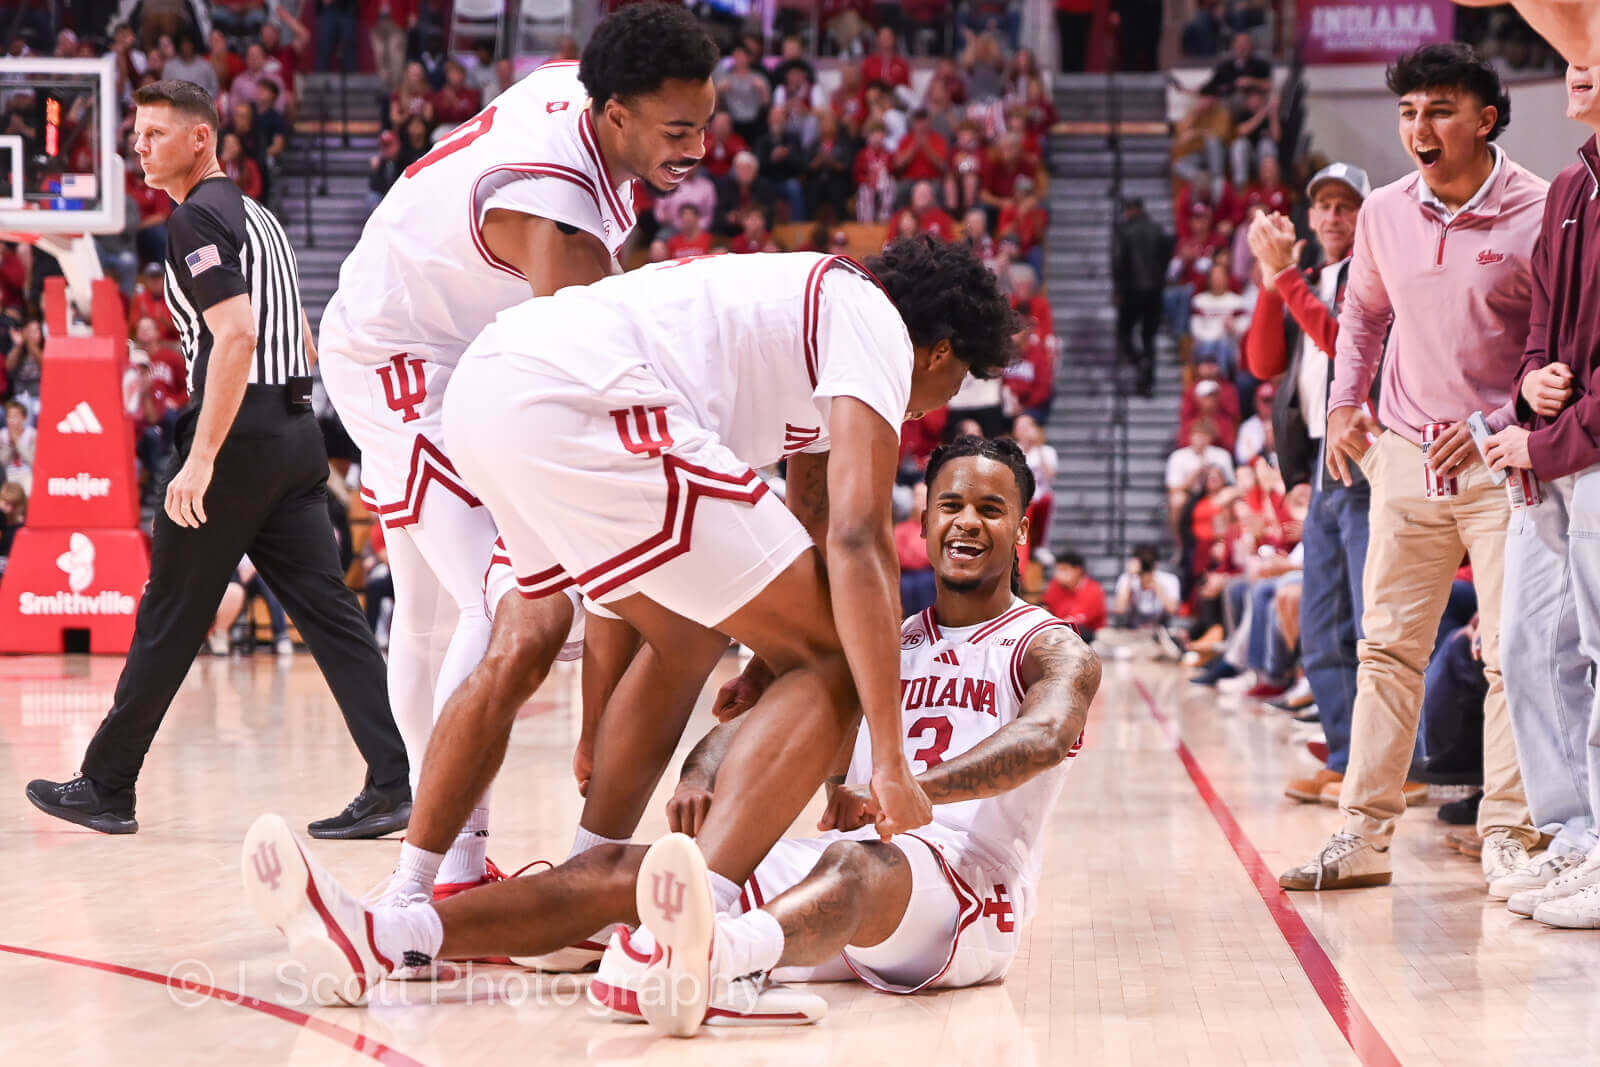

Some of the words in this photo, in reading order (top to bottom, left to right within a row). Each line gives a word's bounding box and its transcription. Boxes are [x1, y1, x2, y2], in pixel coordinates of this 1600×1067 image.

[48, 473, 110, 500] meijer
[19, 591, 134, 614] Smithville
[901, 675, 998, 718] DIANA
[907, 715, 953, 771] 3
